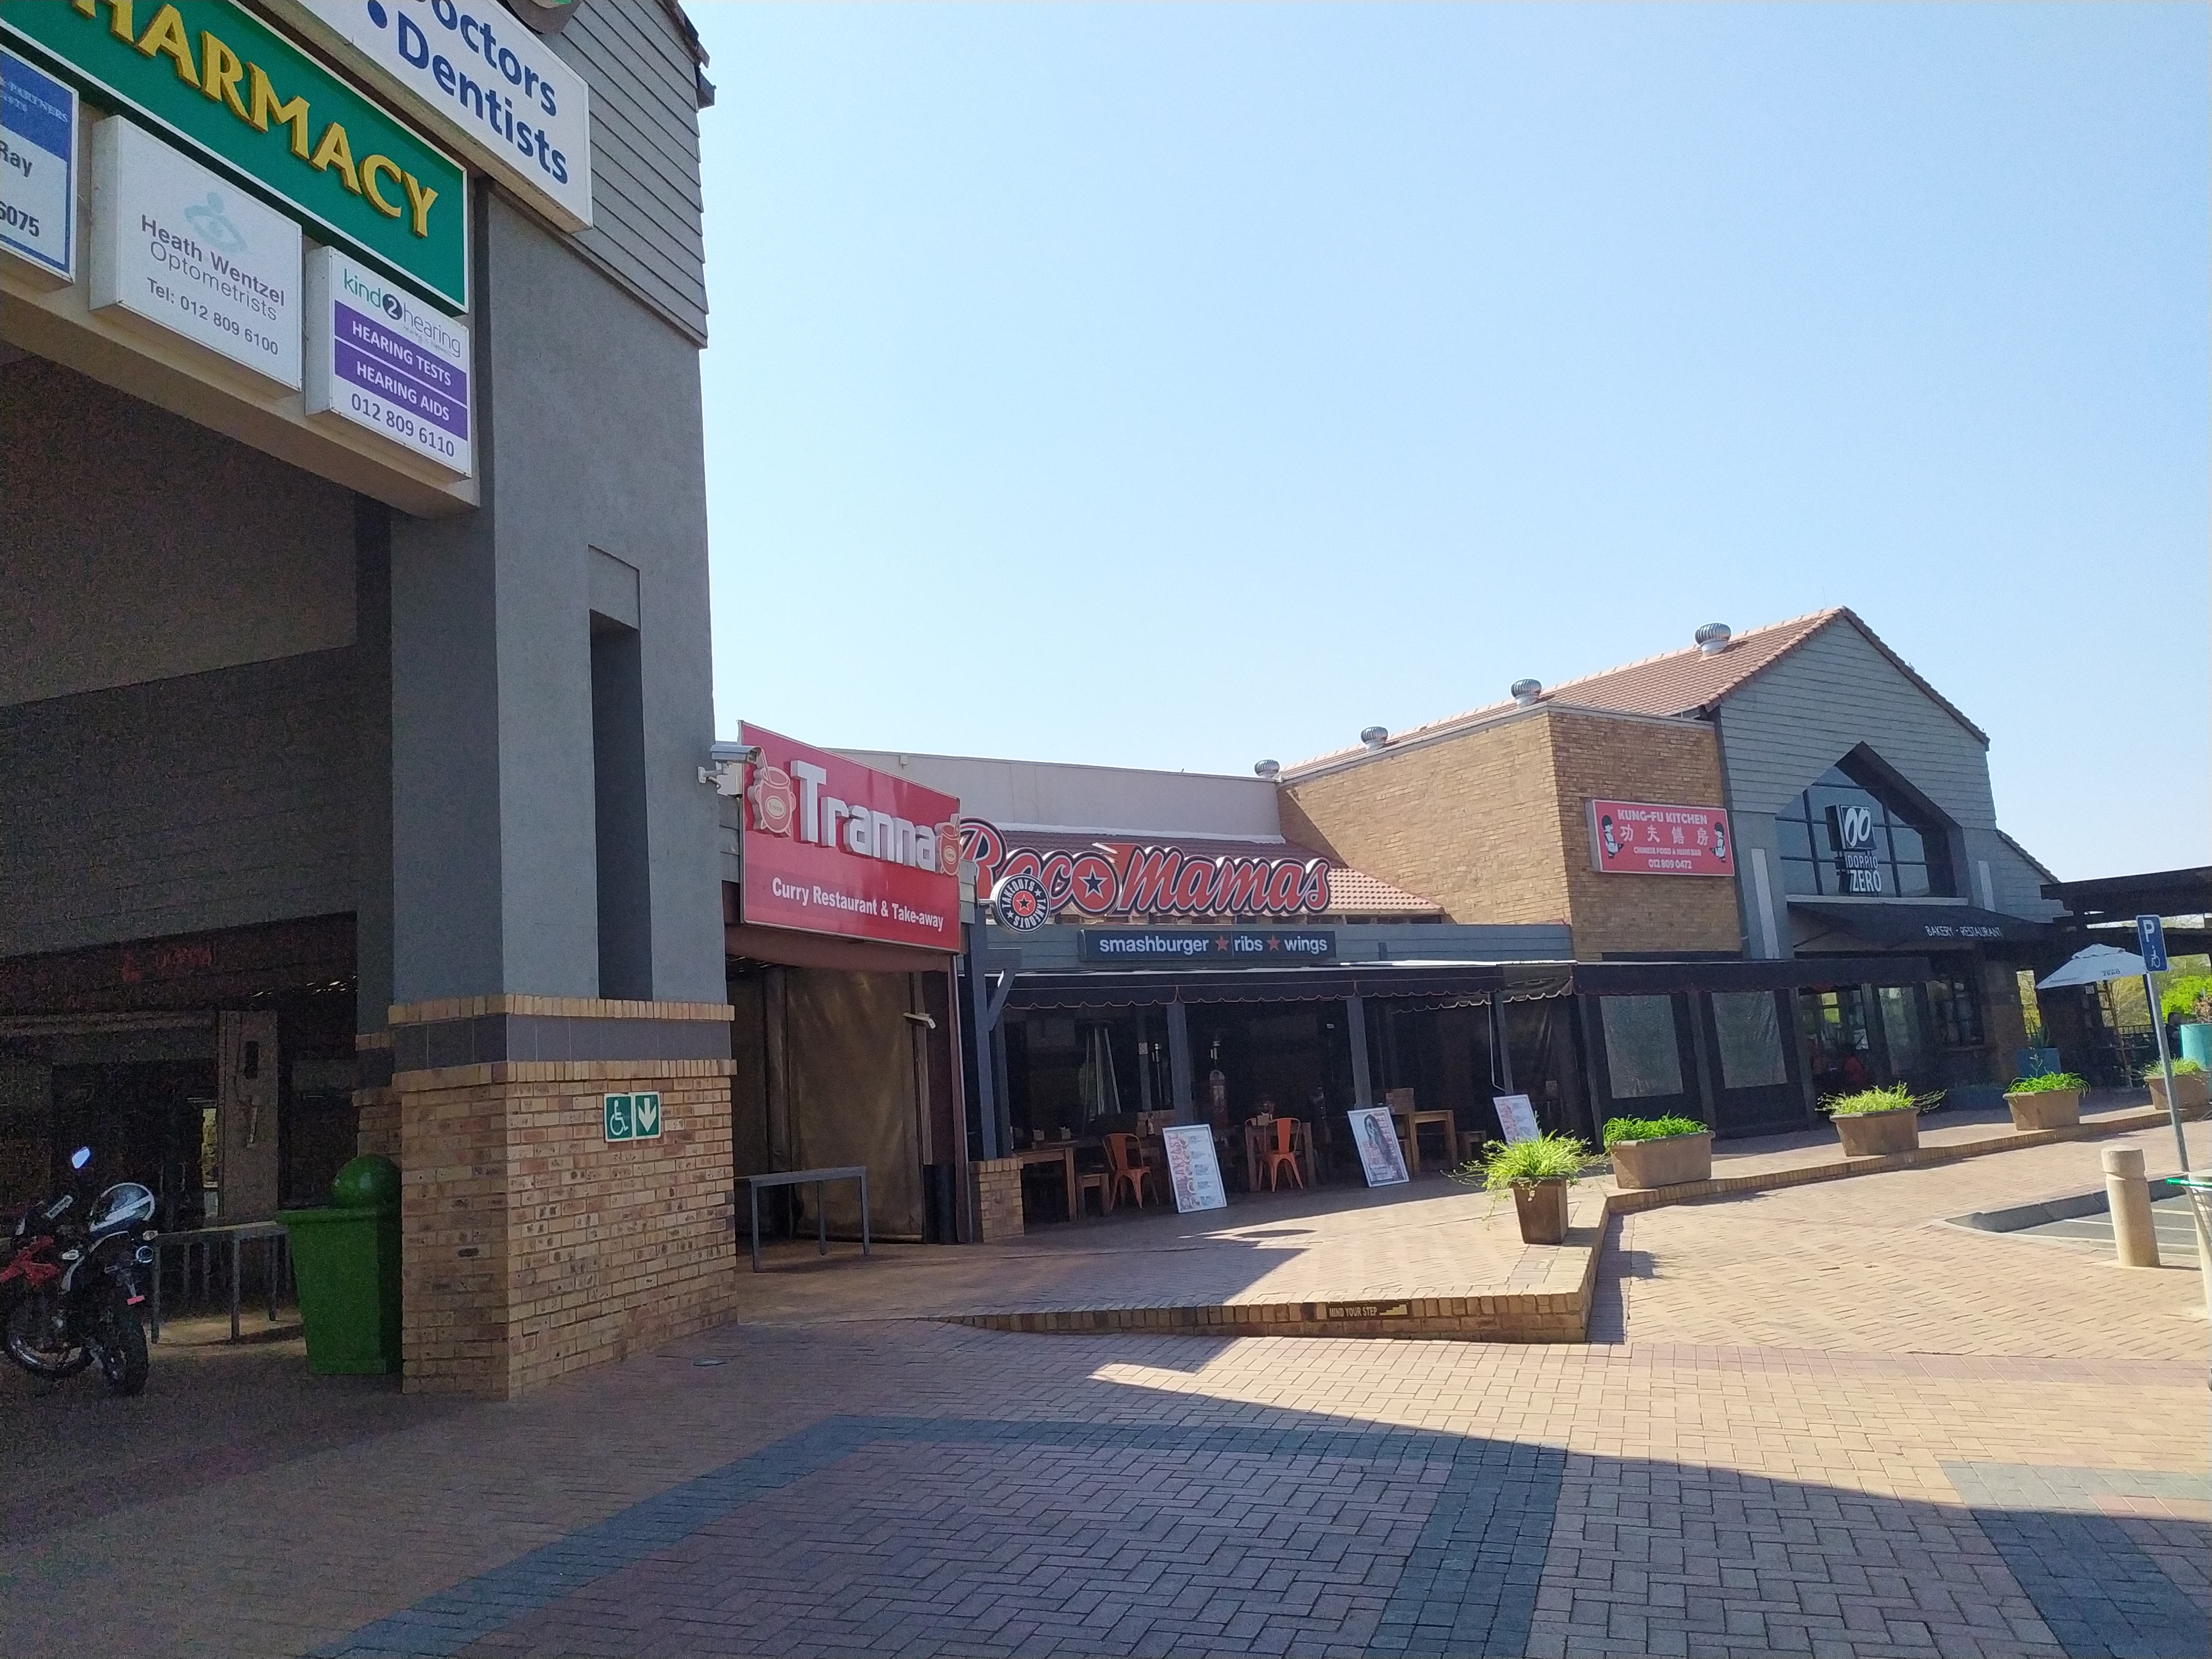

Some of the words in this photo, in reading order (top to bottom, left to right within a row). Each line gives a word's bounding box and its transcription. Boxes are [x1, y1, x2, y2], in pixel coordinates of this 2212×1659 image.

[418, 0, 557, 117] octors
[398, 9, 568, 185] Dentists
[142, 213, 202, 262] Heath
[210, 251, 284, 306] Wentzel
[150, 241, 276, 321] Optometrists
[147, 276, 175, 304] Tel:
[180, 295, 208, 320] 012
[213, 312, 239, 336] 809
[244, 328, 278, 355] 6100
[352, 320, 413, 365] HEARING
[415, 355, 451, 386] TESTS
[357, 361, 417, 404] HEARING
[420, 395, 450, 421] AIDS
[351, 393, 381, 422] 012
[386, 410, 414, 437] 809
[419, 427, 455, 457] 6110
[791, 760, 940, 874] Tranna
[1618, 809, 1664, 822] KUNG-FU
[1666, 812, 1707, 825] KITCHEN
[1846, 854, 1879, 869] DOPPIO
[1850, 869, 1882, 892] ZERO
[773, 878, 809, 906] Curry
[813, 885, 878, 916] Restaurant
[880, 901, 889, 918] &
[891, 903, 944, 932] Take-away
[1001, 879, 1035, 909] TAKEOUTS
[1013, 898, 1046, 928] TAKEOUTS
[1099, 928, 1209, 955] smashburger
[1234, 928, 1263, 952] ribs
[1284, 930, 1327, 955] wings
[1924, 926, 1954, 936] BAKERY
[1959, 926, 2002, 937] RESTAURANT
[2142, 920, 2155, 943] P
[1329, 1307, 1344, 1317] MIND
[1345, 1307, 1362, 1317] YOUR
[1363, 1306, 1378, 1316] STEP
